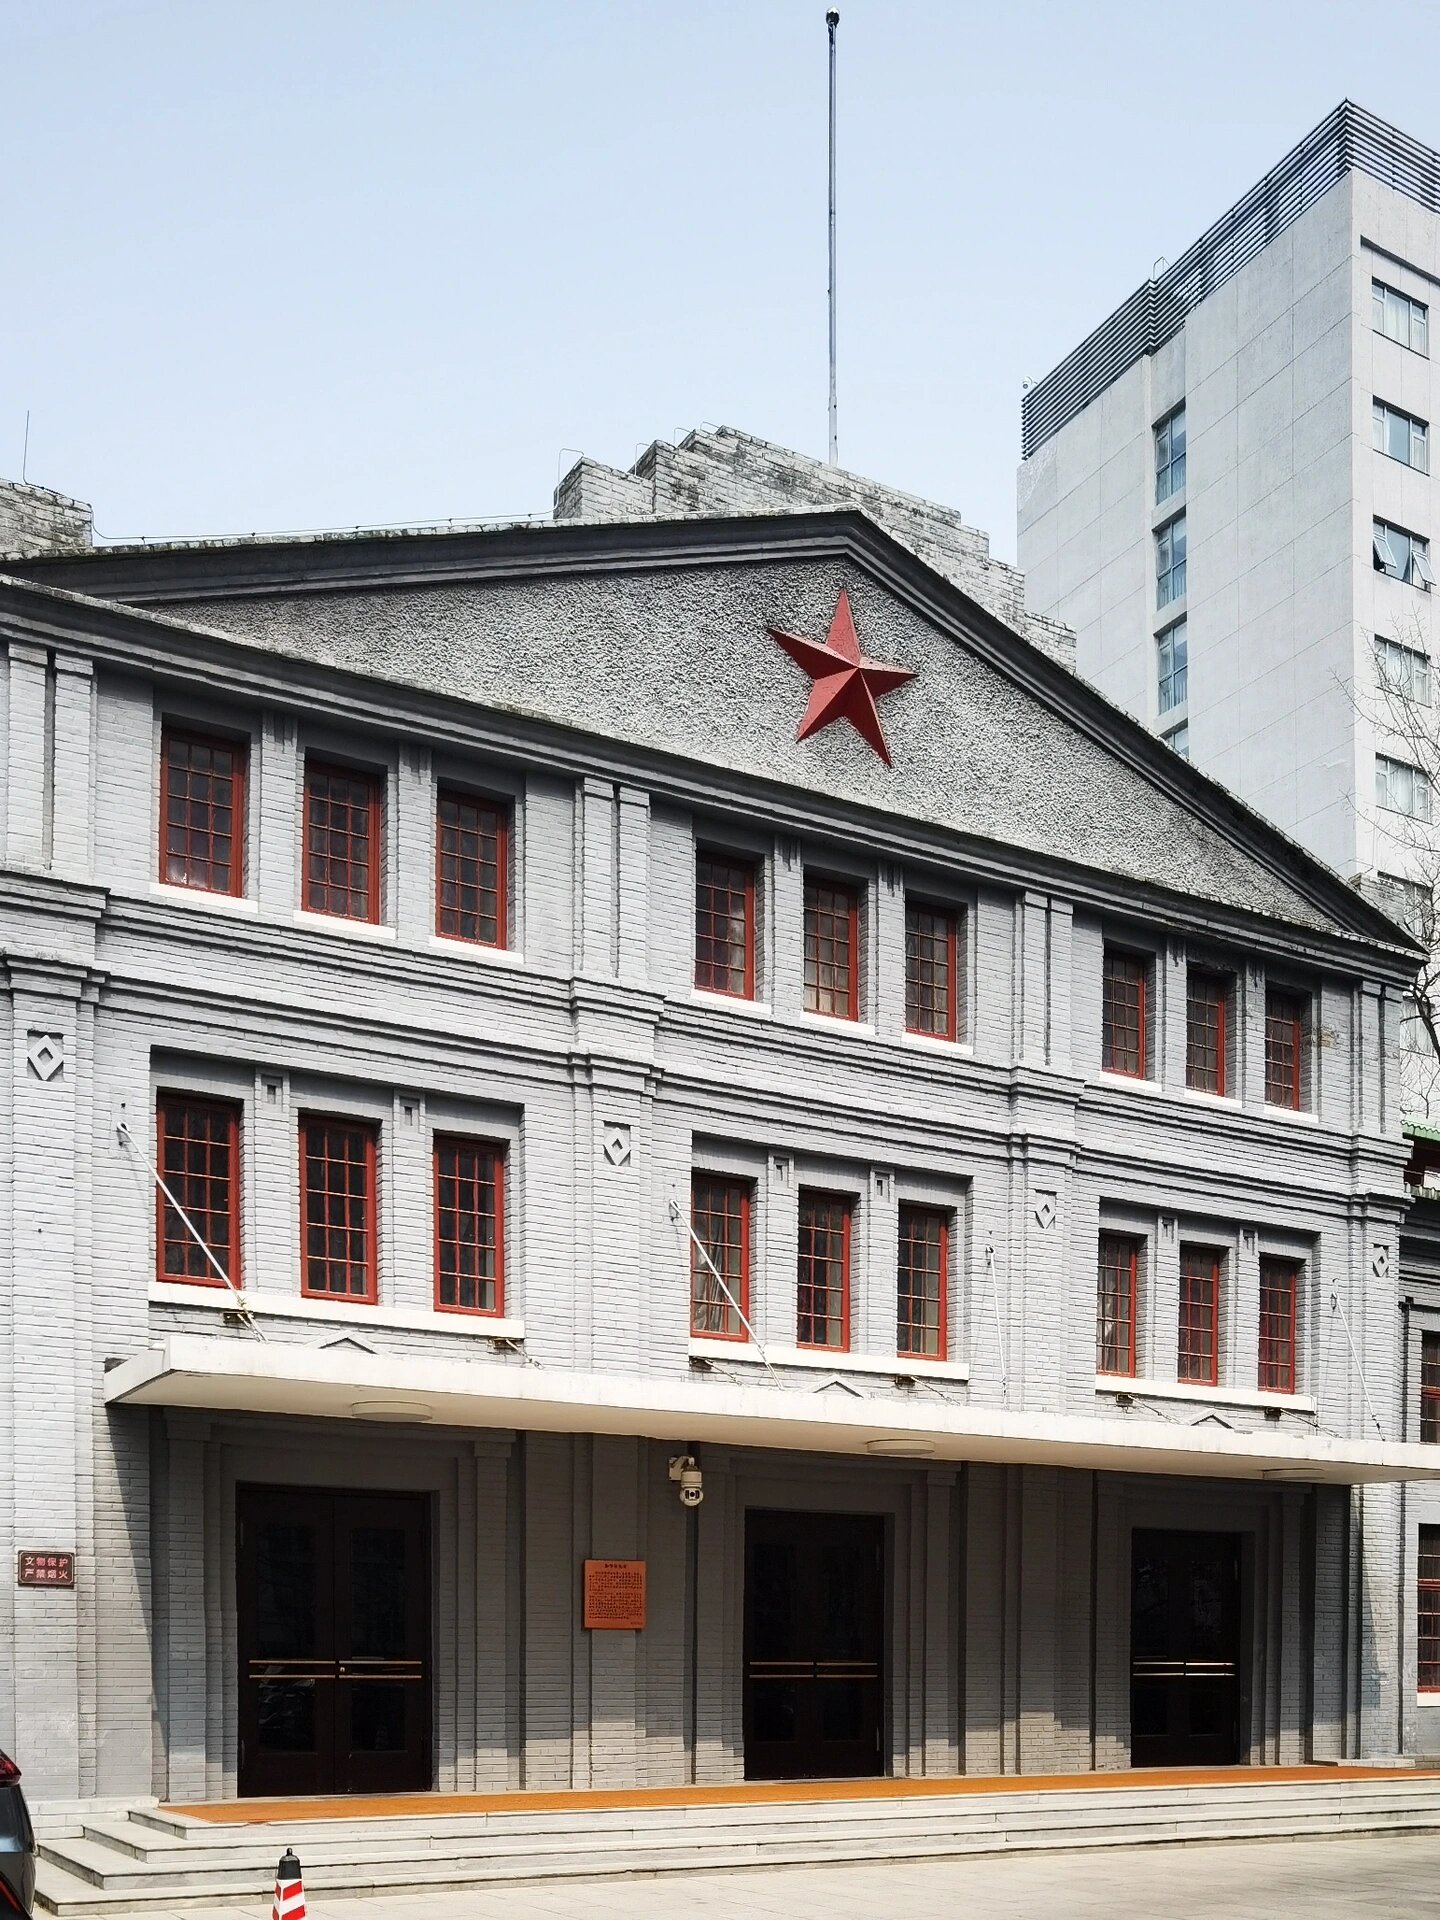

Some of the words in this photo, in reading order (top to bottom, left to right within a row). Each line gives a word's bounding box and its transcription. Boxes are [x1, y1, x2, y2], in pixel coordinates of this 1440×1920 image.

[24, 1556, 68, 1567] 文物保护
[24, 1569, 68, 1579] 严禁烟火
